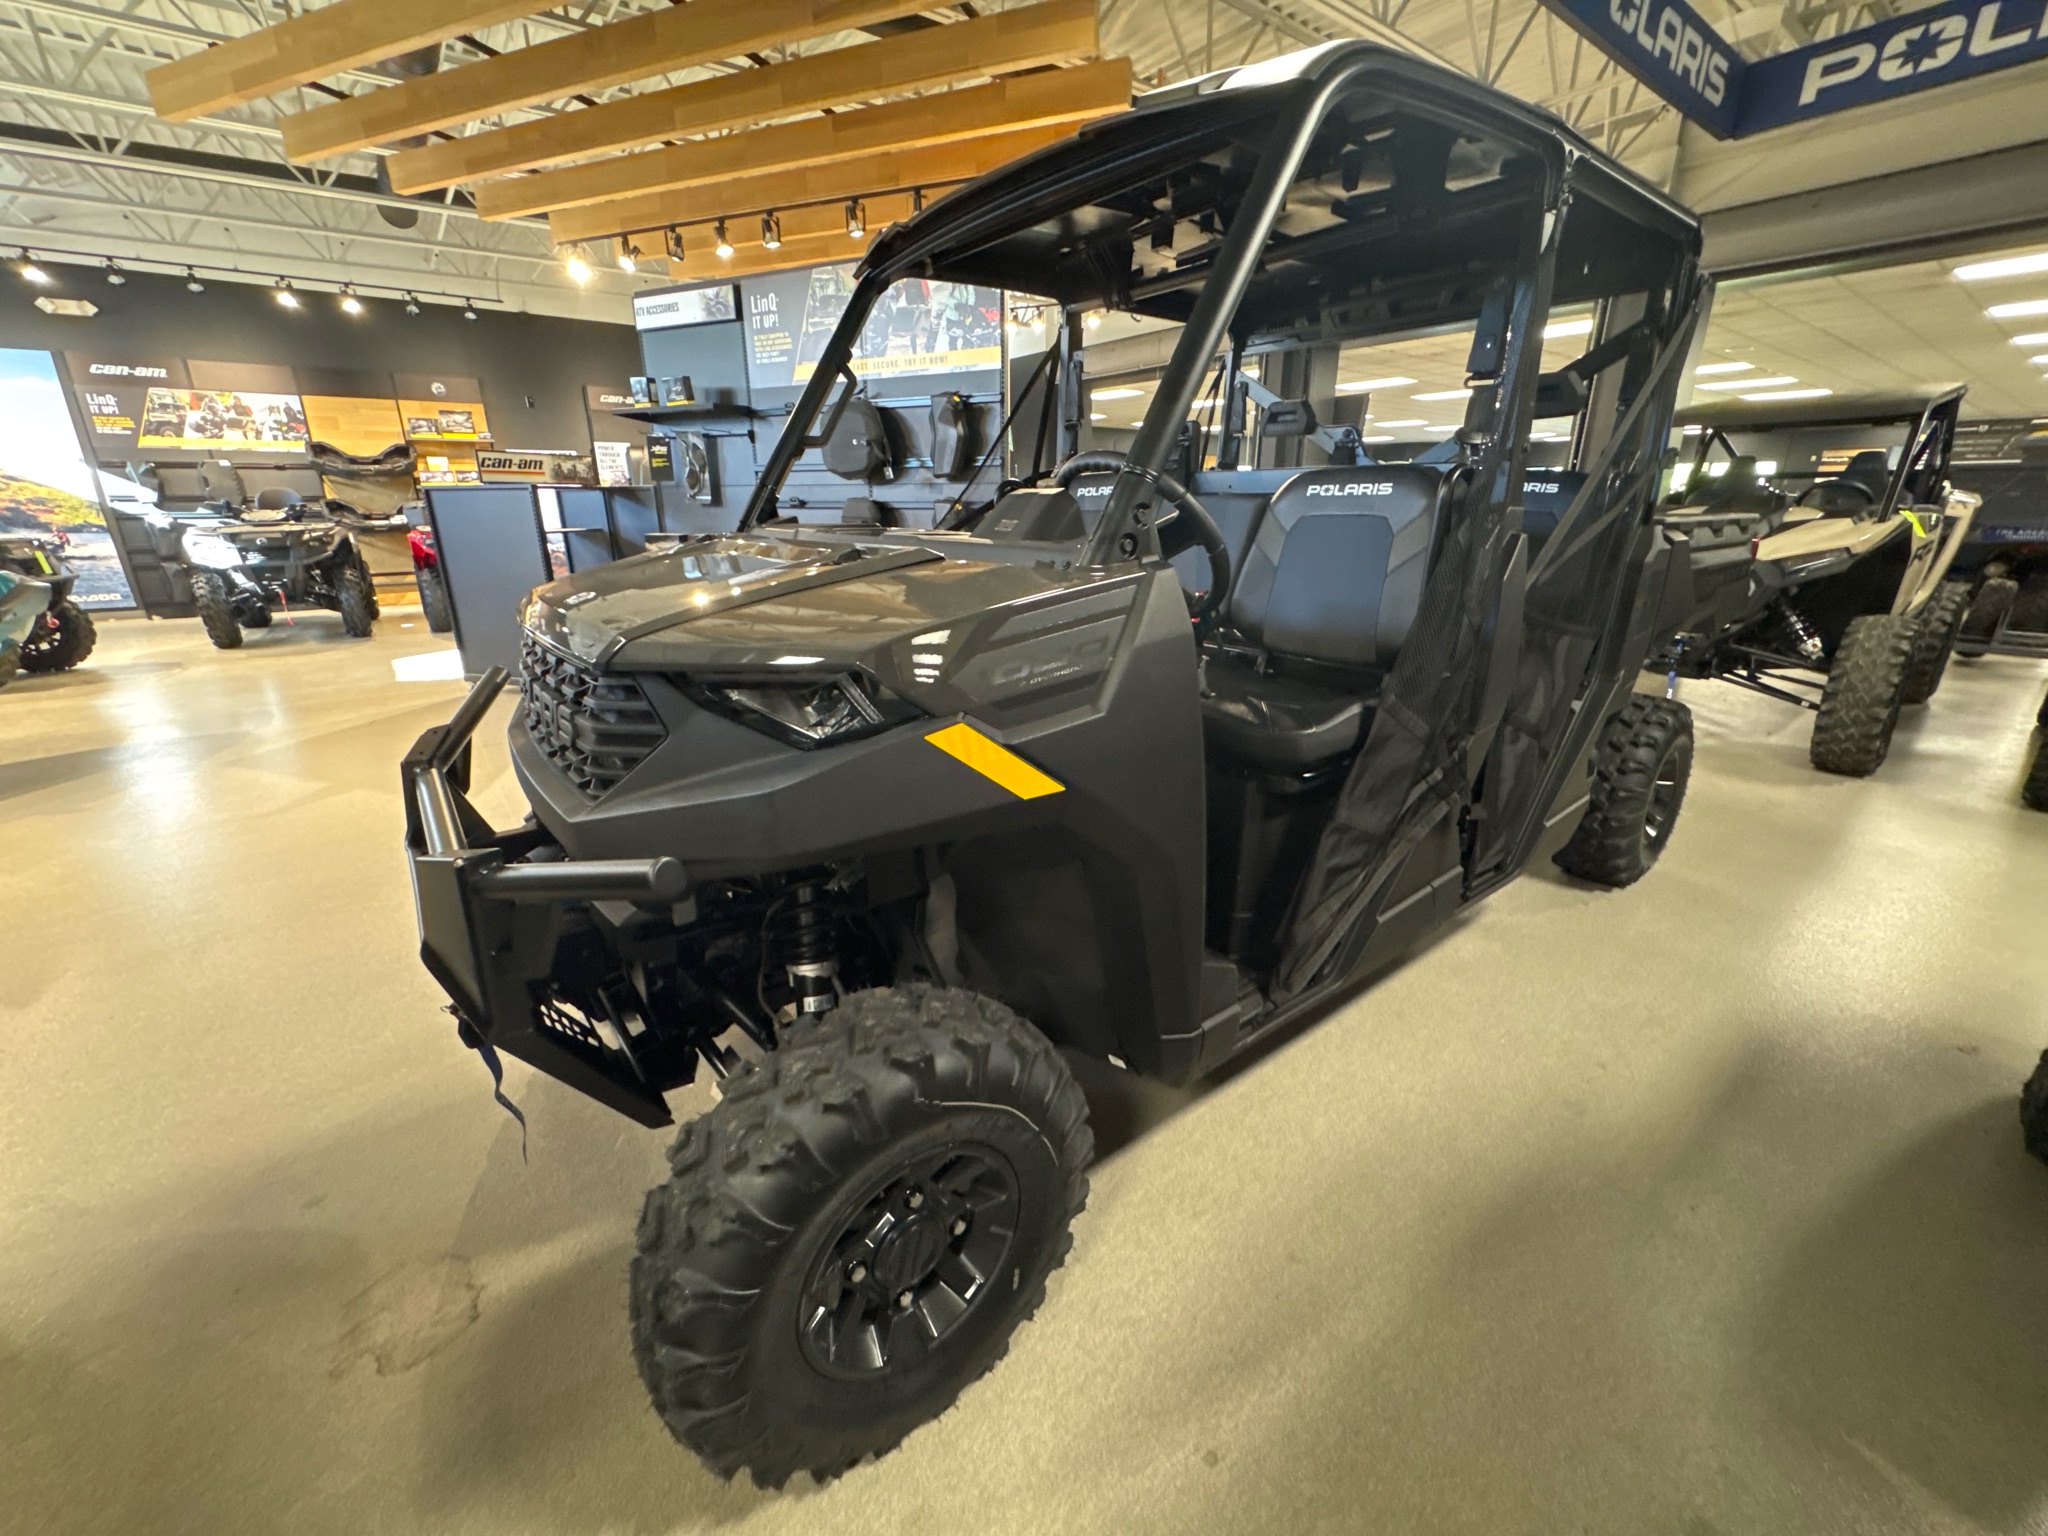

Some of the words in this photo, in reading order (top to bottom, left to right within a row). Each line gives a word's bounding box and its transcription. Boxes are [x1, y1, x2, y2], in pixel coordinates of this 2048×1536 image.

[1798, 0, 2048, 106] POL
[646, 301, 680, 316] ACCESSORIES
[751, 293, 777, 314] LinQ
[752, 315, 761, 329] IT
[763, 314, 779, 328] UP!
[904, 357, 917, 367] TRY
[919, 356, 927, 365] IT
[89, 363, 168, 378] can-am
[600, 394, 635, 404] can-a
[480, 456, 544, 470] can-am
[1306, 482, 1394, 497] POLARIS
